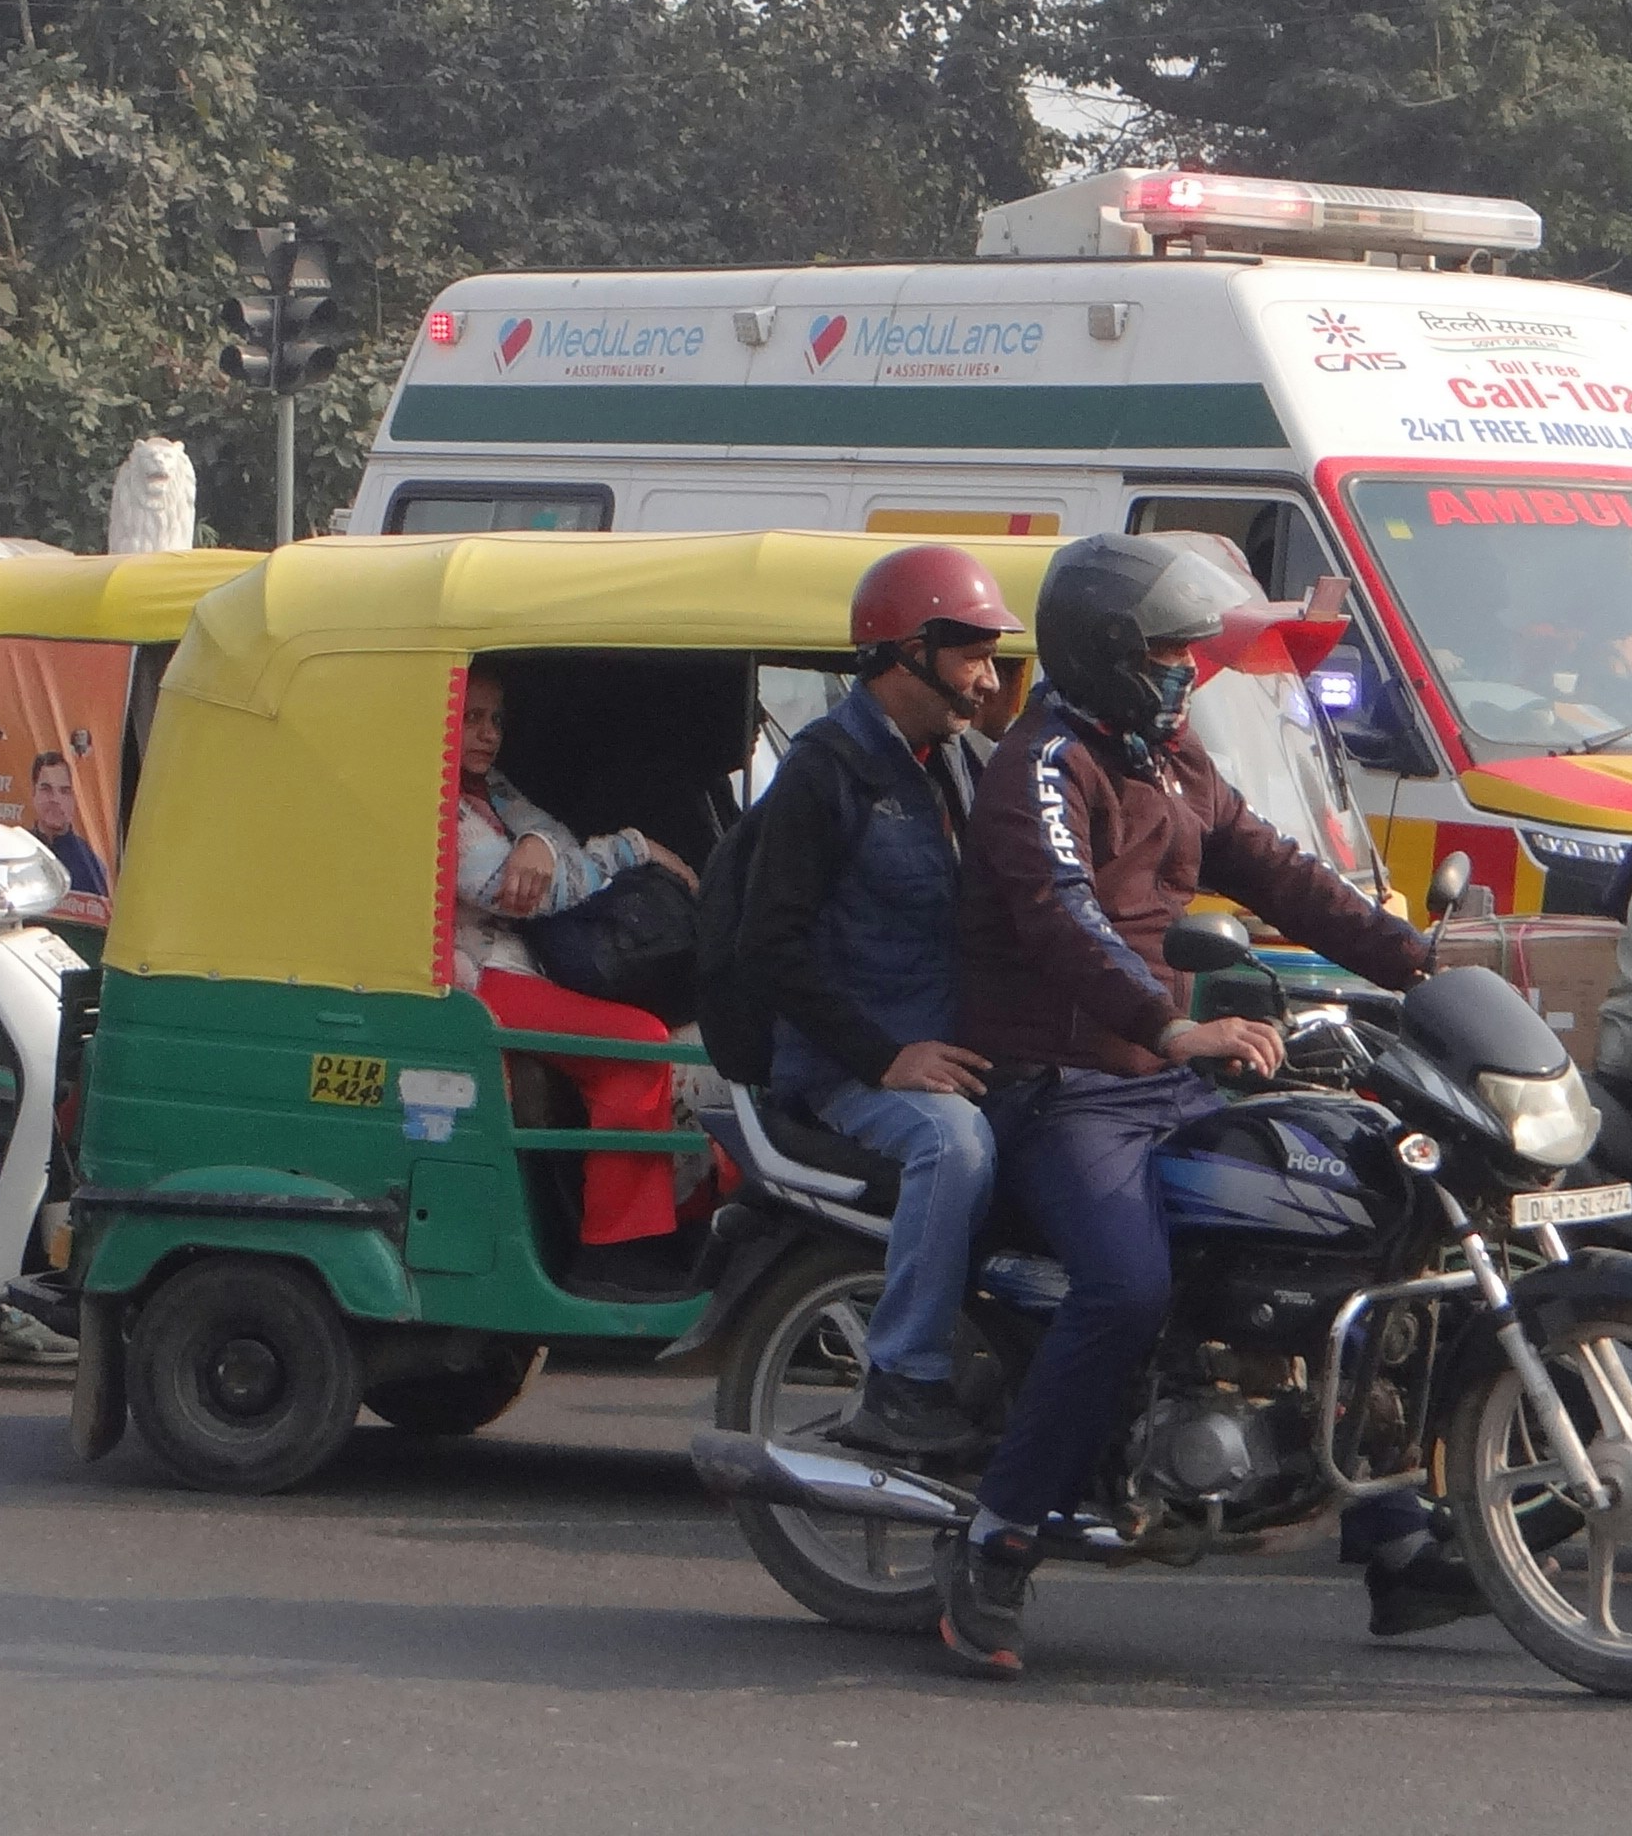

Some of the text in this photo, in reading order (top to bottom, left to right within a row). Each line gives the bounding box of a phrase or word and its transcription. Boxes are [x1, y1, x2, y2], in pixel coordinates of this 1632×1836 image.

[854, 314, 1044, 357] MeduLance
[1418, 310, 1578, 340] दिल्ली सरकार
[537, 319, 704, 358] MeduLance
[571, 364, 657, 379] ASSISTING LIVES
[893, 362, 991, 378] ASSISTING LIVES
[1314, 352, 1407, 372] CATS
[1486, 359, 1581, 378] Toll Free
[1401, 418, 1467, 443] 24x7
[1468, 419, 1539, 445] FREE
[1287, 1152, 1347, 1177] Hero
